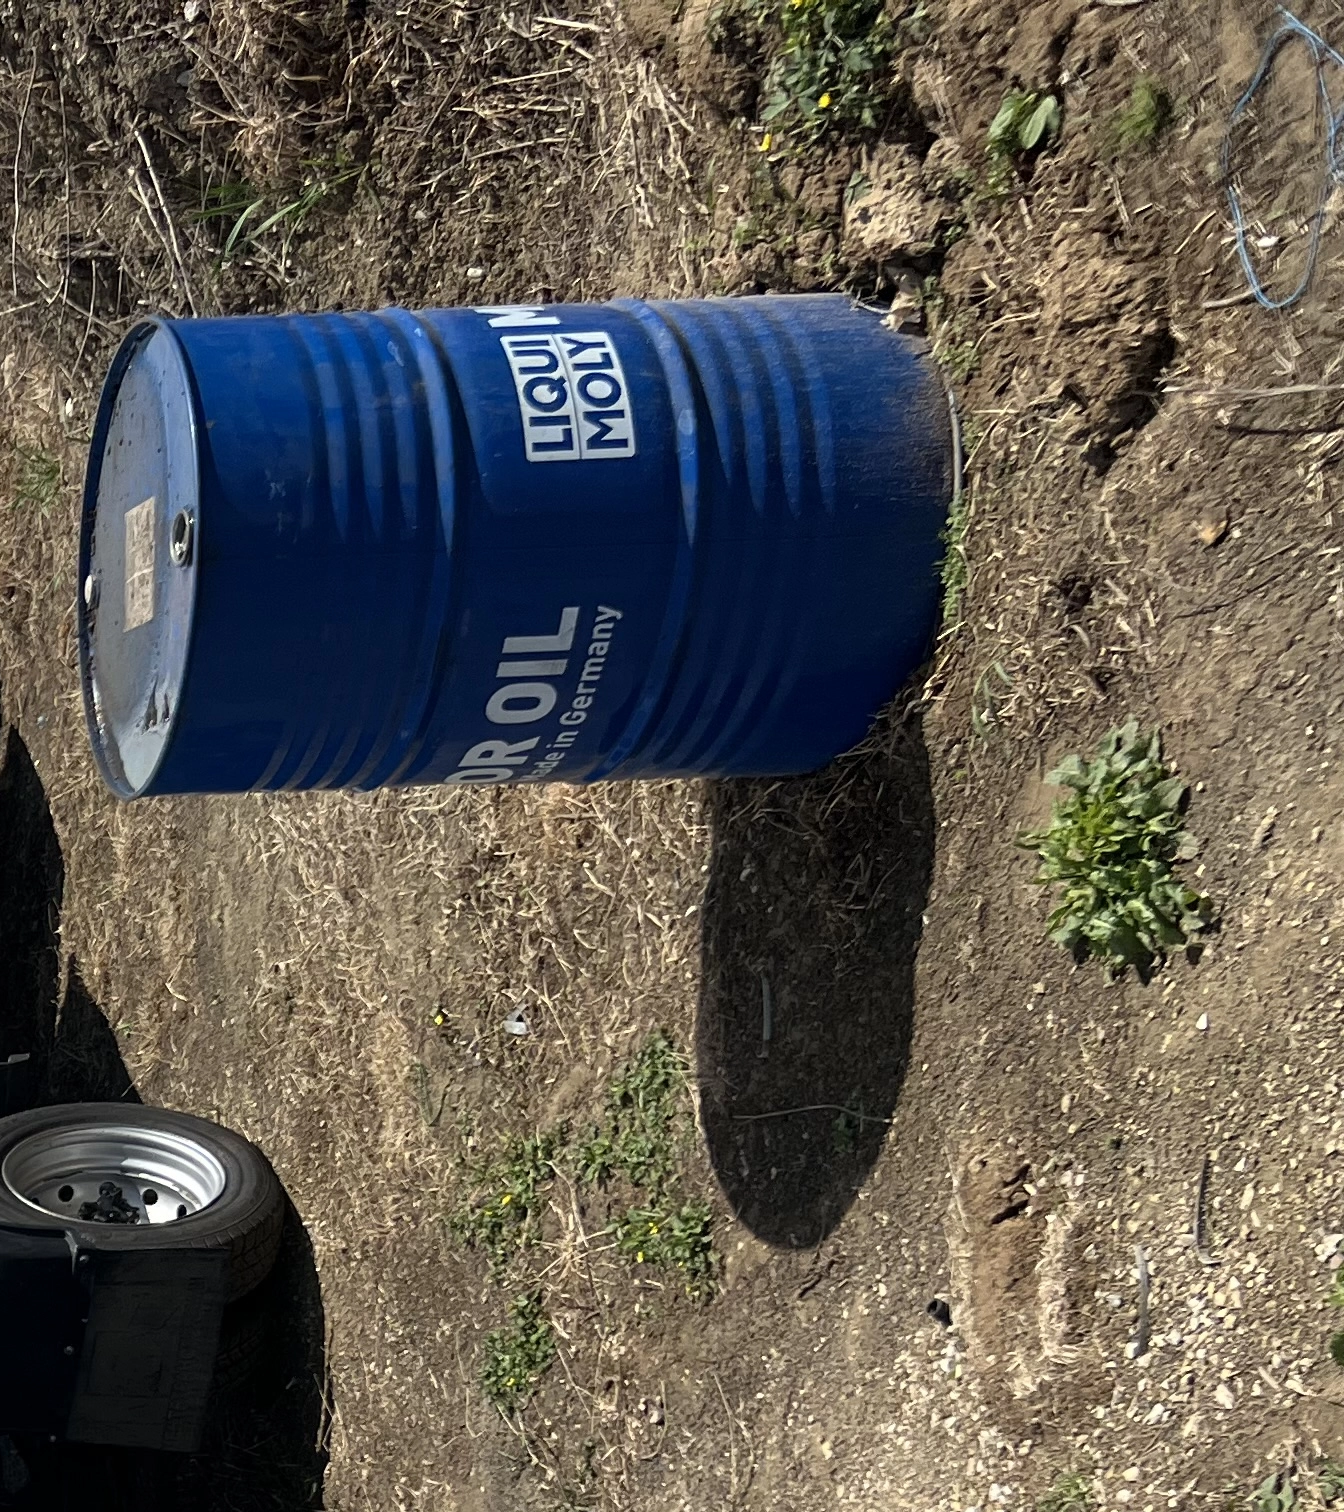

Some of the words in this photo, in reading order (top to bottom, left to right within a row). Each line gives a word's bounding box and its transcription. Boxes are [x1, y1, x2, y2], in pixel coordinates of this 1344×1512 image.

[508, 339, 574, 453] LIQUI
[561, 337, 628, 450] MOLY
[484, 606, 581, 725] OIL
[561, 605, 624, 726] Germany
[549, 731, 579, 748] in
